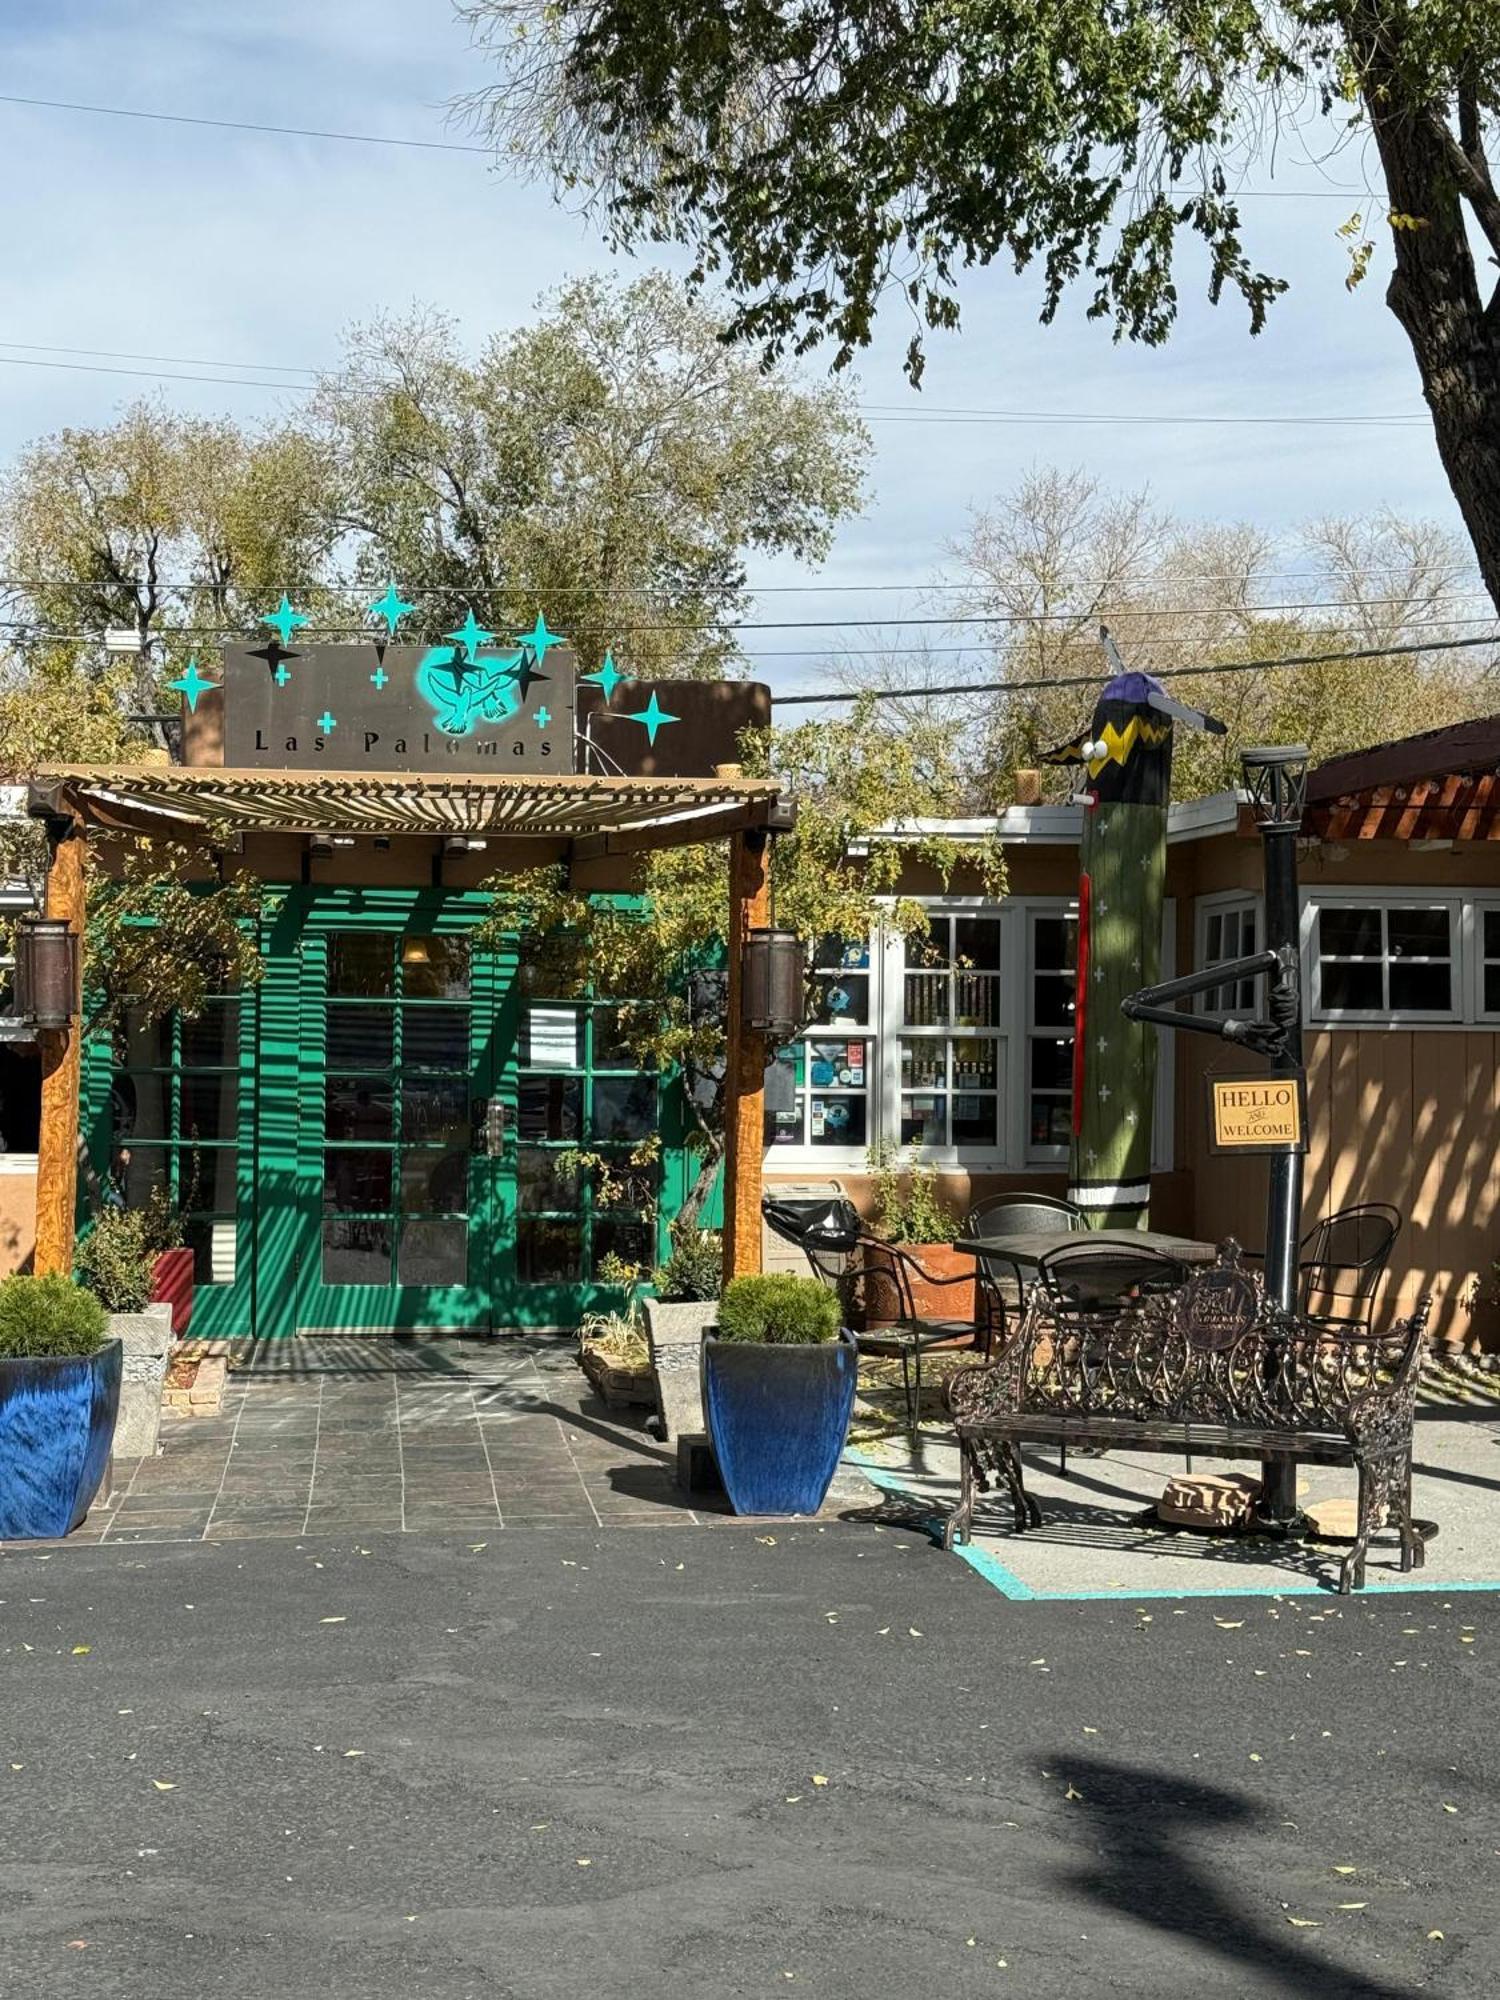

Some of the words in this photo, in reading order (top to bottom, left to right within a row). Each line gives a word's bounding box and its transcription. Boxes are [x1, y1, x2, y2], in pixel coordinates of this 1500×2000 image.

[255, 730, 325, 751] Las
[364, 731, 552, 756] Palomas
[1222, 1089, 1291, 1108] HELLO
[1223, 1124, 1293, 1136] WELCOME
